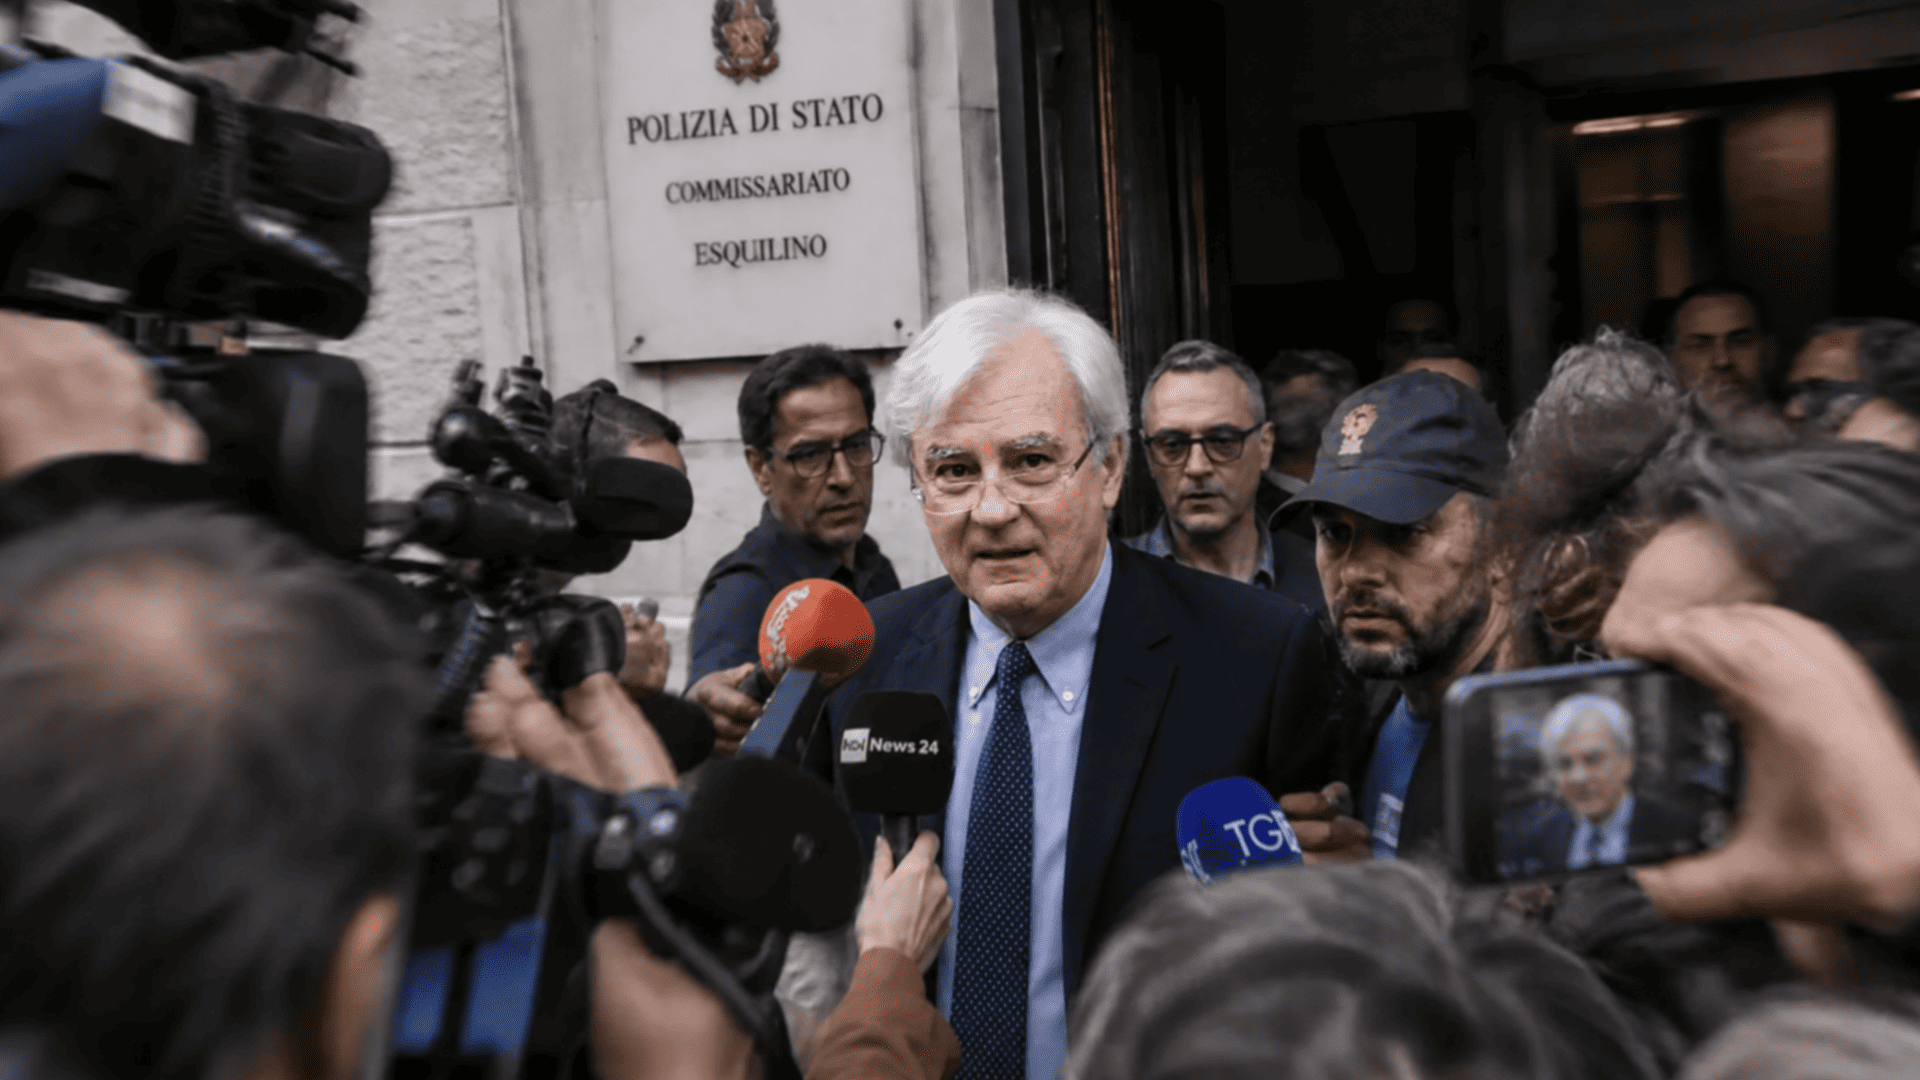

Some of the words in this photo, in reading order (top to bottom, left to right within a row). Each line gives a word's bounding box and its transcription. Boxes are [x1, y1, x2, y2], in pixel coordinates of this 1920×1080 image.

[627, 107, 738, 144] POLIZIA
[750, 103, 780, 133] DI
[792, 93, 883, 129] STATO
[665, 167, 851, 204] COMMISSARIATO
[694, 234, 828, 268] ESQUILINO
[869, 737, 916, 754] News
[918, 740, 940, 755] 24
